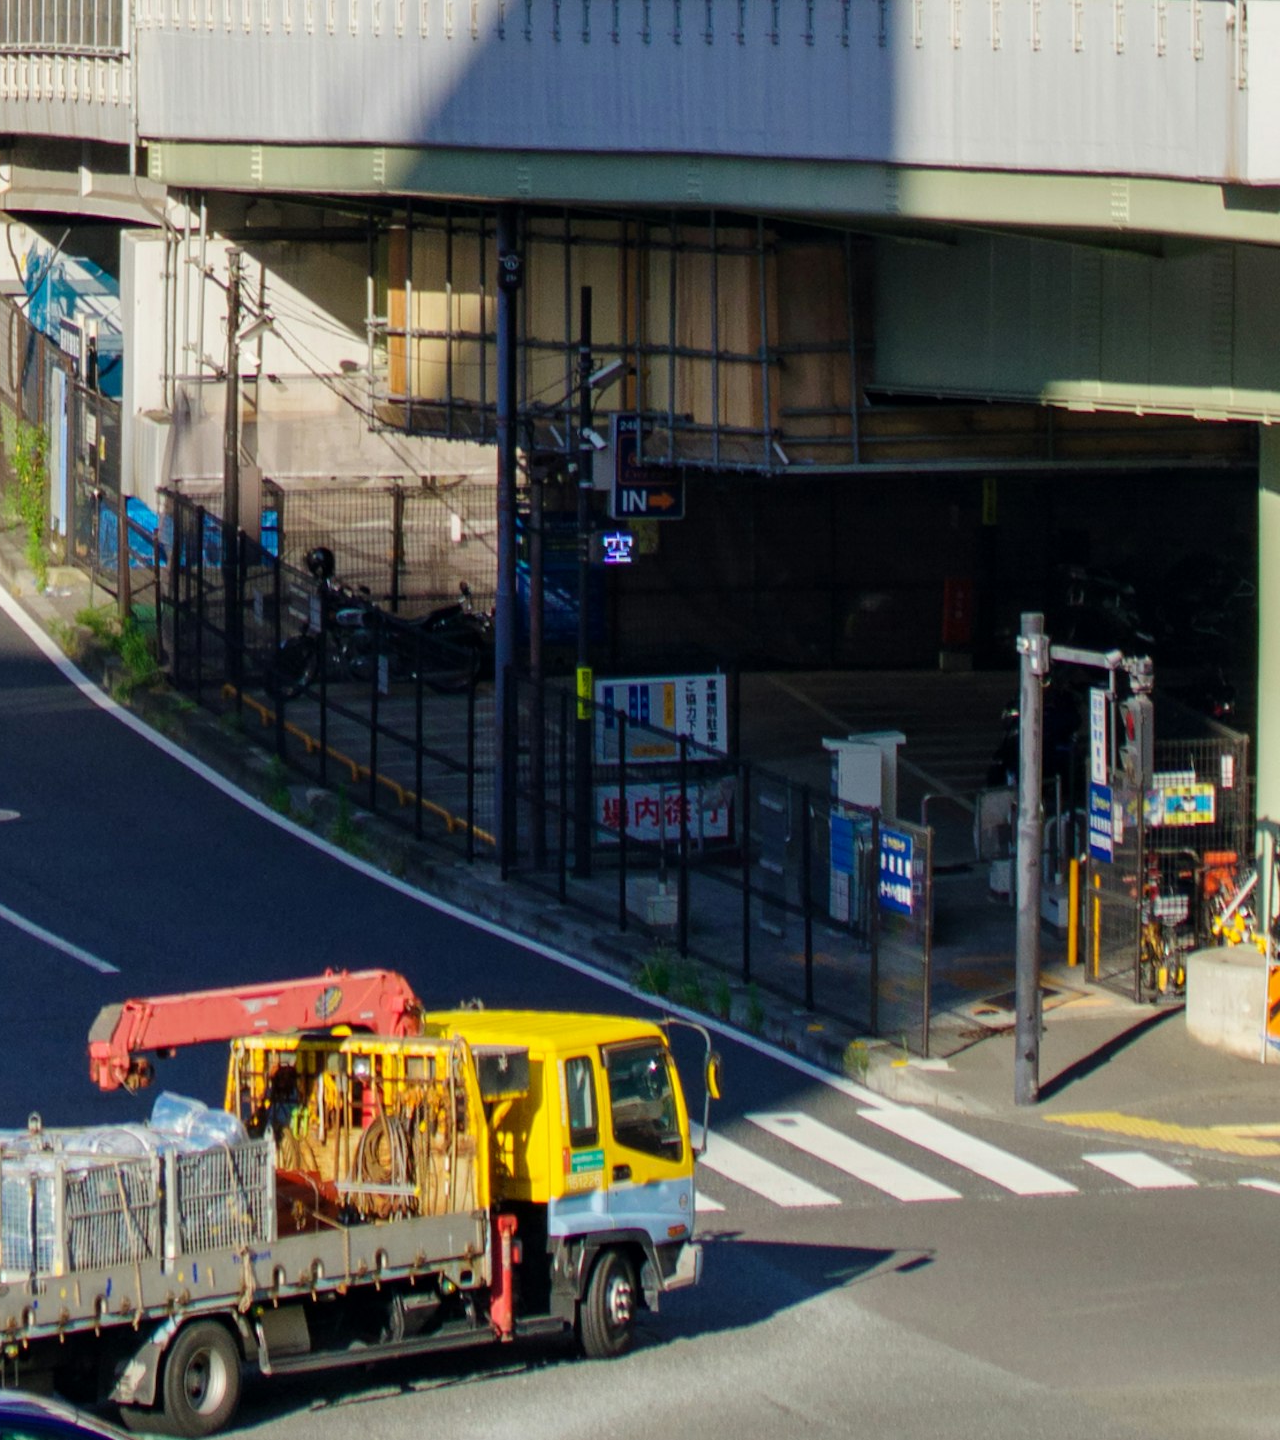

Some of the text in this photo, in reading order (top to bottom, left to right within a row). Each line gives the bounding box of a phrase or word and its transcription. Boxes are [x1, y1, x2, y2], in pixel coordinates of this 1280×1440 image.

[622, 489, 647, 513] IN
[603, 531, 633, 563] 空
[603, 794, 725, 828] 場内徐
